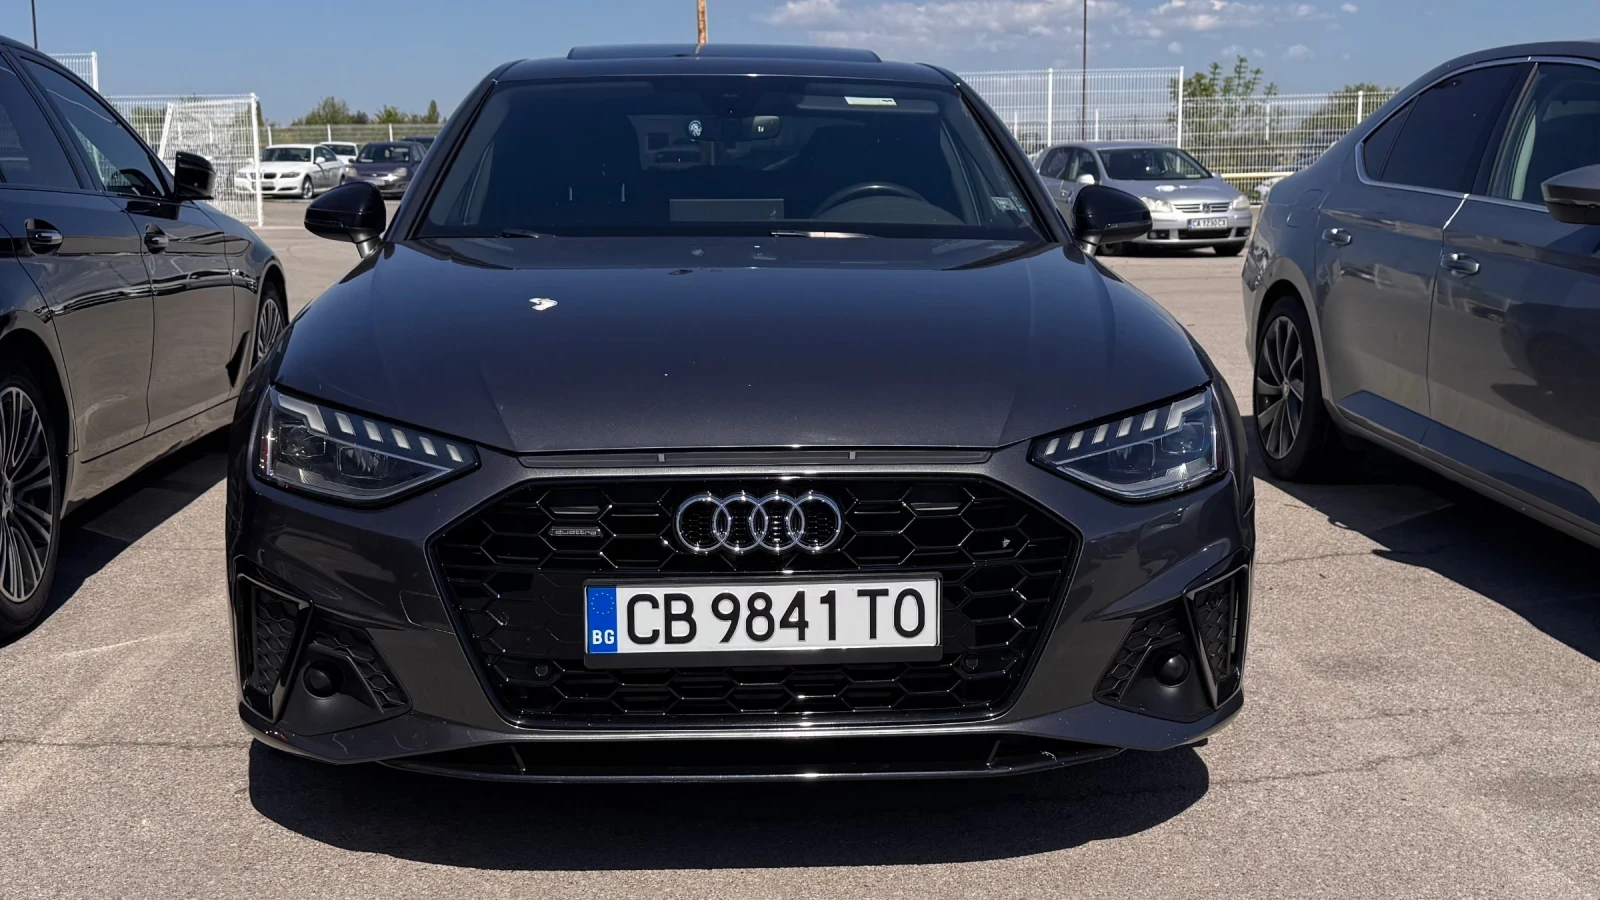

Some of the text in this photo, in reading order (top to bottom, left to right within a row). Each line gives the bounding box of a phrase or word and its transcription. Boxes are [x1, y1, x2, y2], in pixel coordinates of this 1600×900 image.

[626, 587, 927, 645] CB 9841 TO
[592, 629, 615, 645] BG
